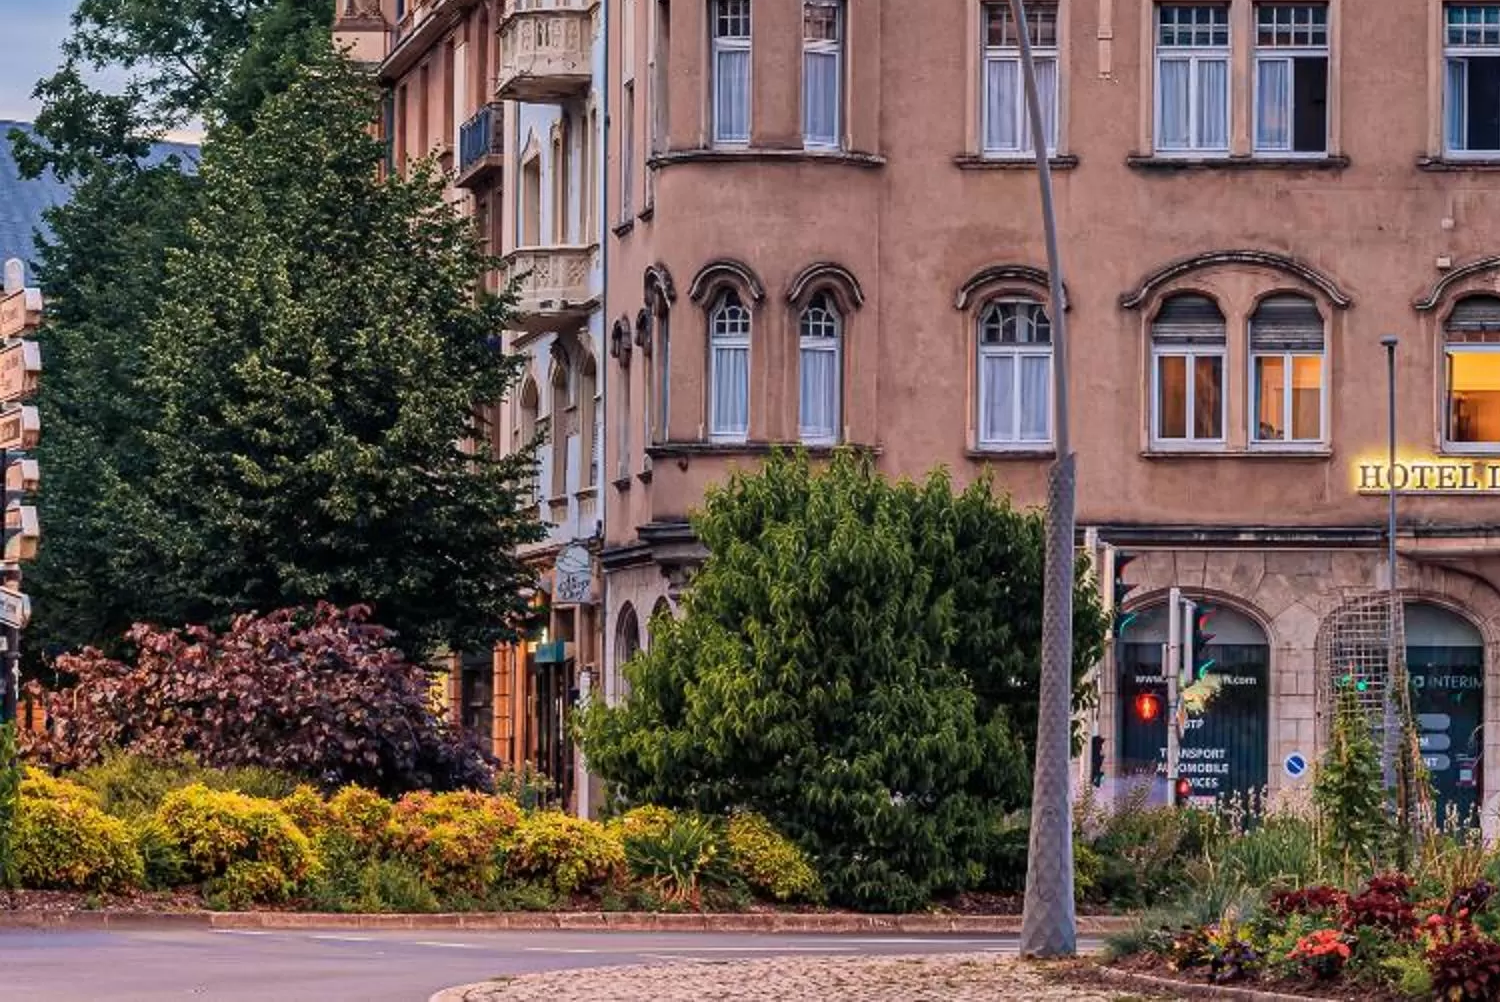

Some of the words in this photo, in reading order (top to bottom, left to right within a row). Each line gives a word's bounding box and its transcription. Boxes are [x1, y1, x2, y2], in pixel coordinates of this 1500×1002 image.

[1359, 463, 1479, 489] HOTEL
[1160, 747, 1226, 759] TANSPORT
[1156, 763, 1229, 774] AOMOBILE
